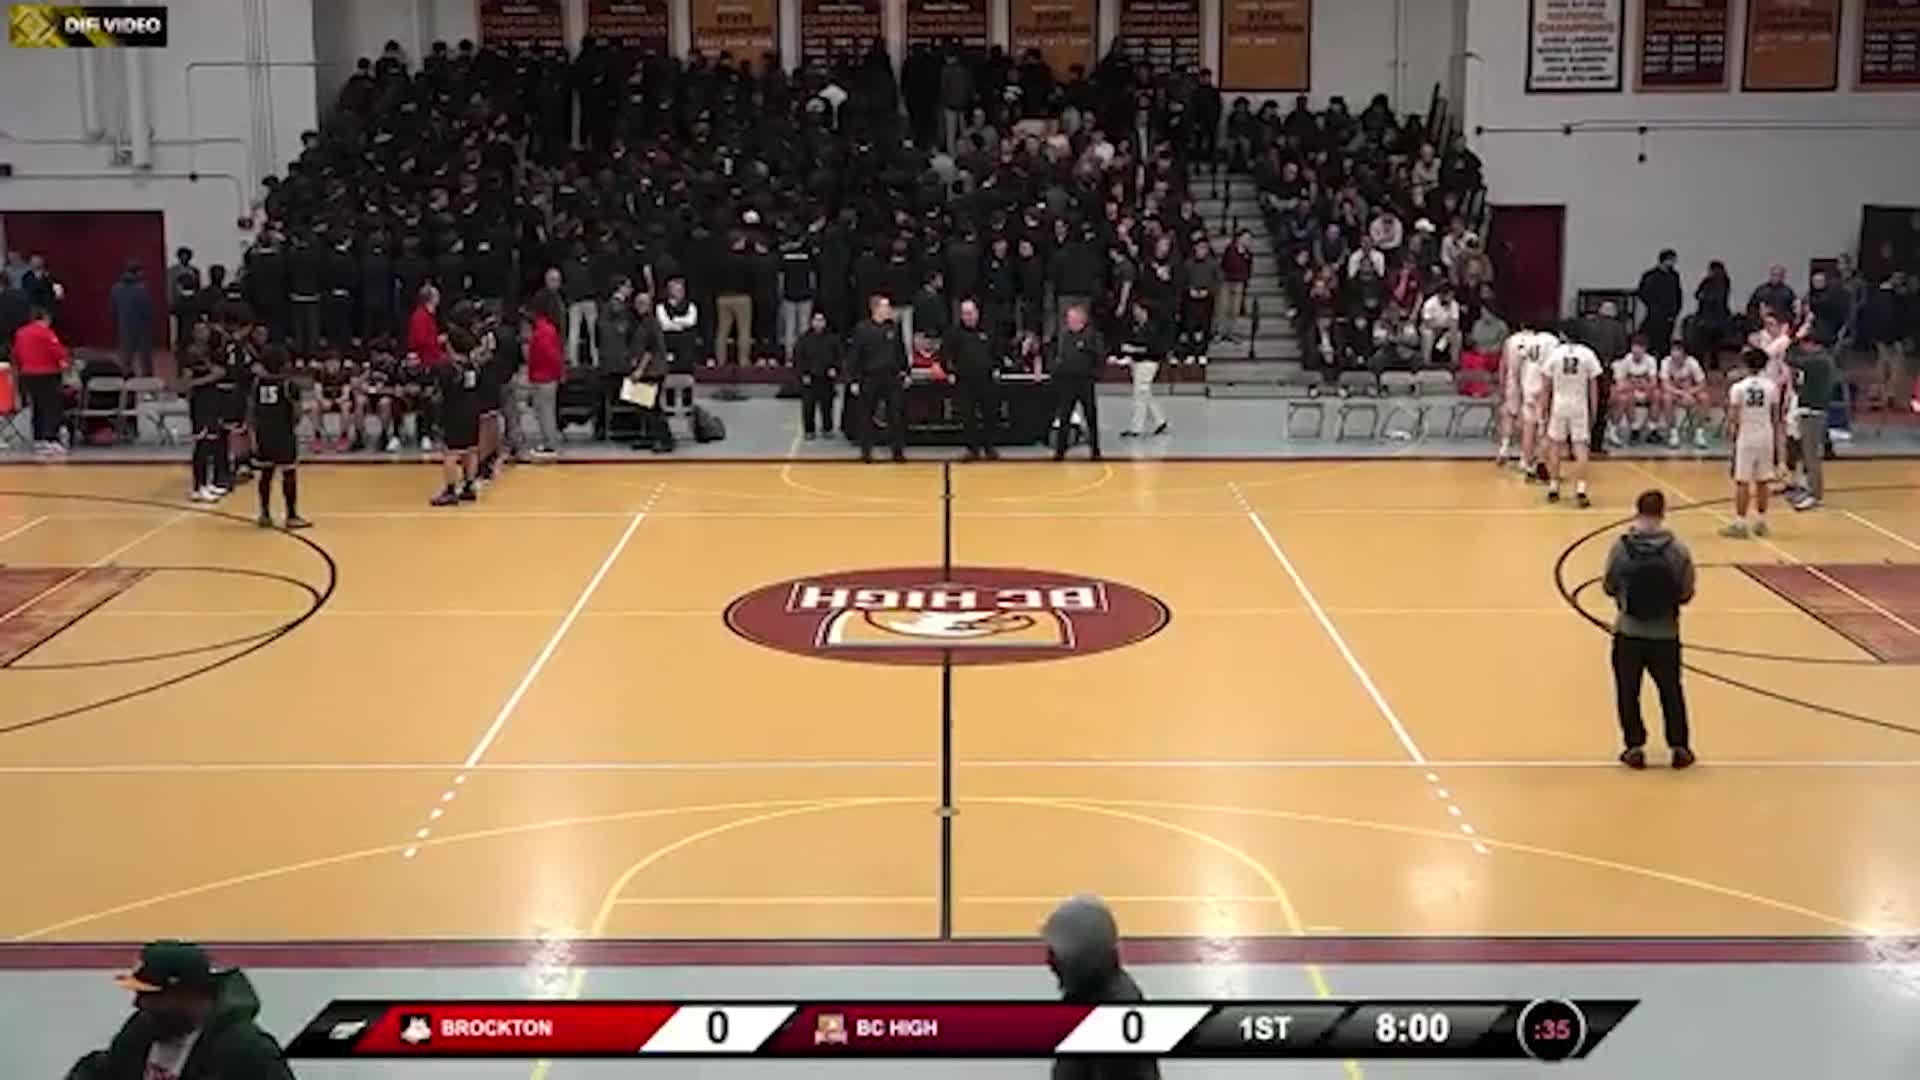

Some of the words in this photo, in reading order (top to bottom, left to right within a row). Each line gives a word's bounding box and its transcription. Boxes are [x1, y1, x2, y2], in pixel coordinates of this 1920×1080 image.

[1745, 387, 1765, 408] 32
[802, 586, 976, 611] HIGH
[997, 586, 1095, 611] BC
